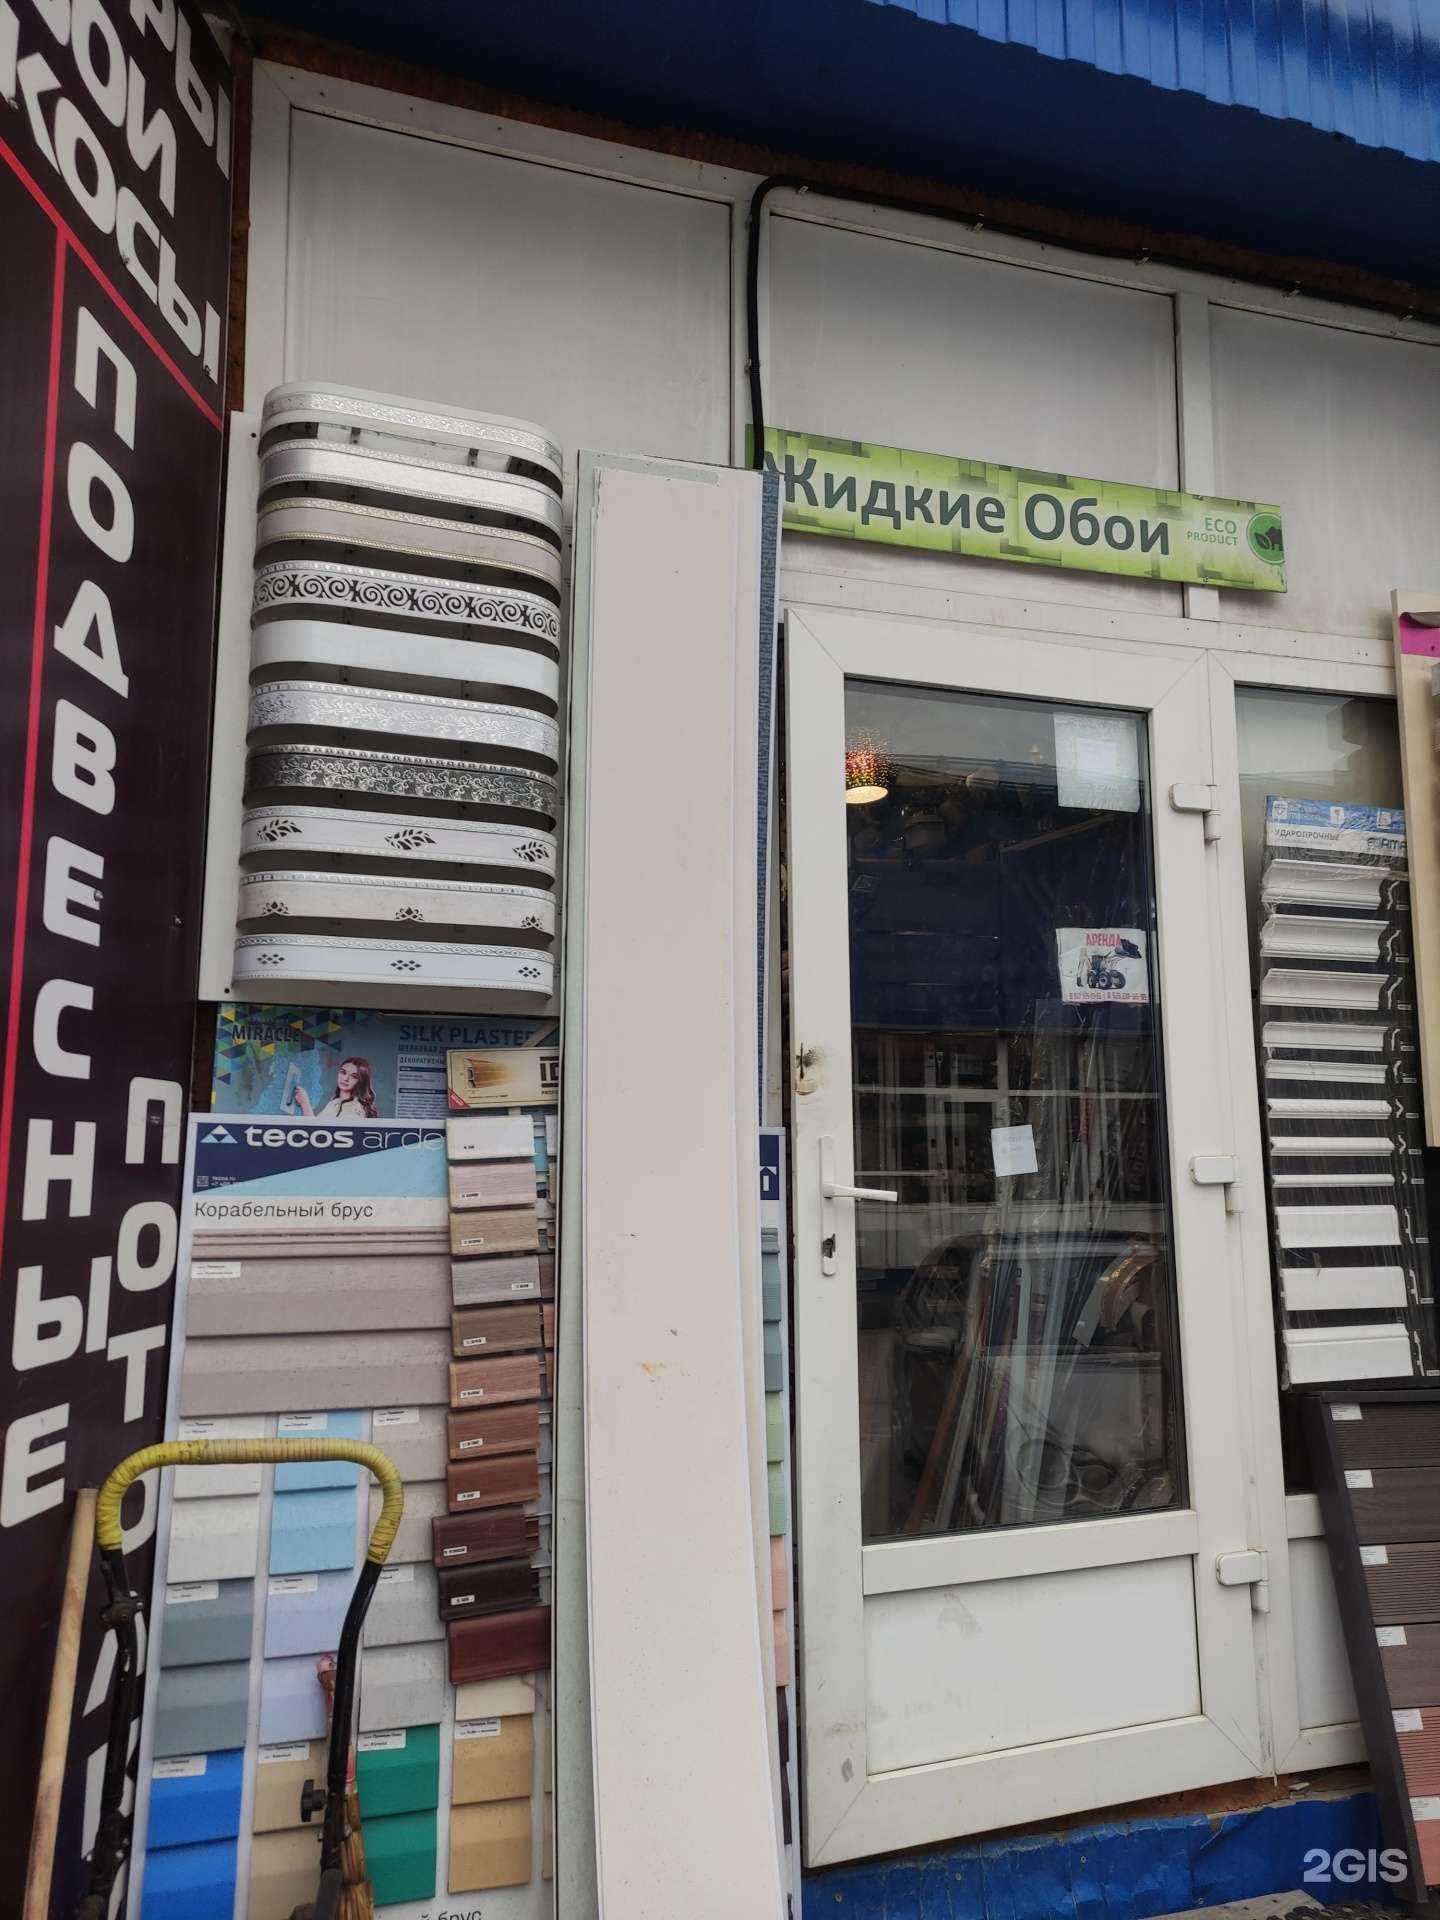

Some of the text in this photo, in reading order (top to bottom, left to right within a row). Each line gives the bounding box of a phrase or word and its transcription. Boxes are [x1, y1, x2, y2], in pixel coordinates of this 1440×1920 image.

[764, 450, 1170, 555] Жидкие Обои
[1204, 517, 1238, 535] ECO
[1187, 530, 1239, 546] PRODUCT
[0, 305, 138, 1528] ПОДВЕСНЫЕ
[1086, 932, 1121, 948] АРЕНДА
[231, 1024, 301, 1043] MIRACLE
[400, 1024, 435, 1043] SILK
[245, 1127, 354, 1149] tecos
[194, 1201, 374, 1221] Корабельный брус
